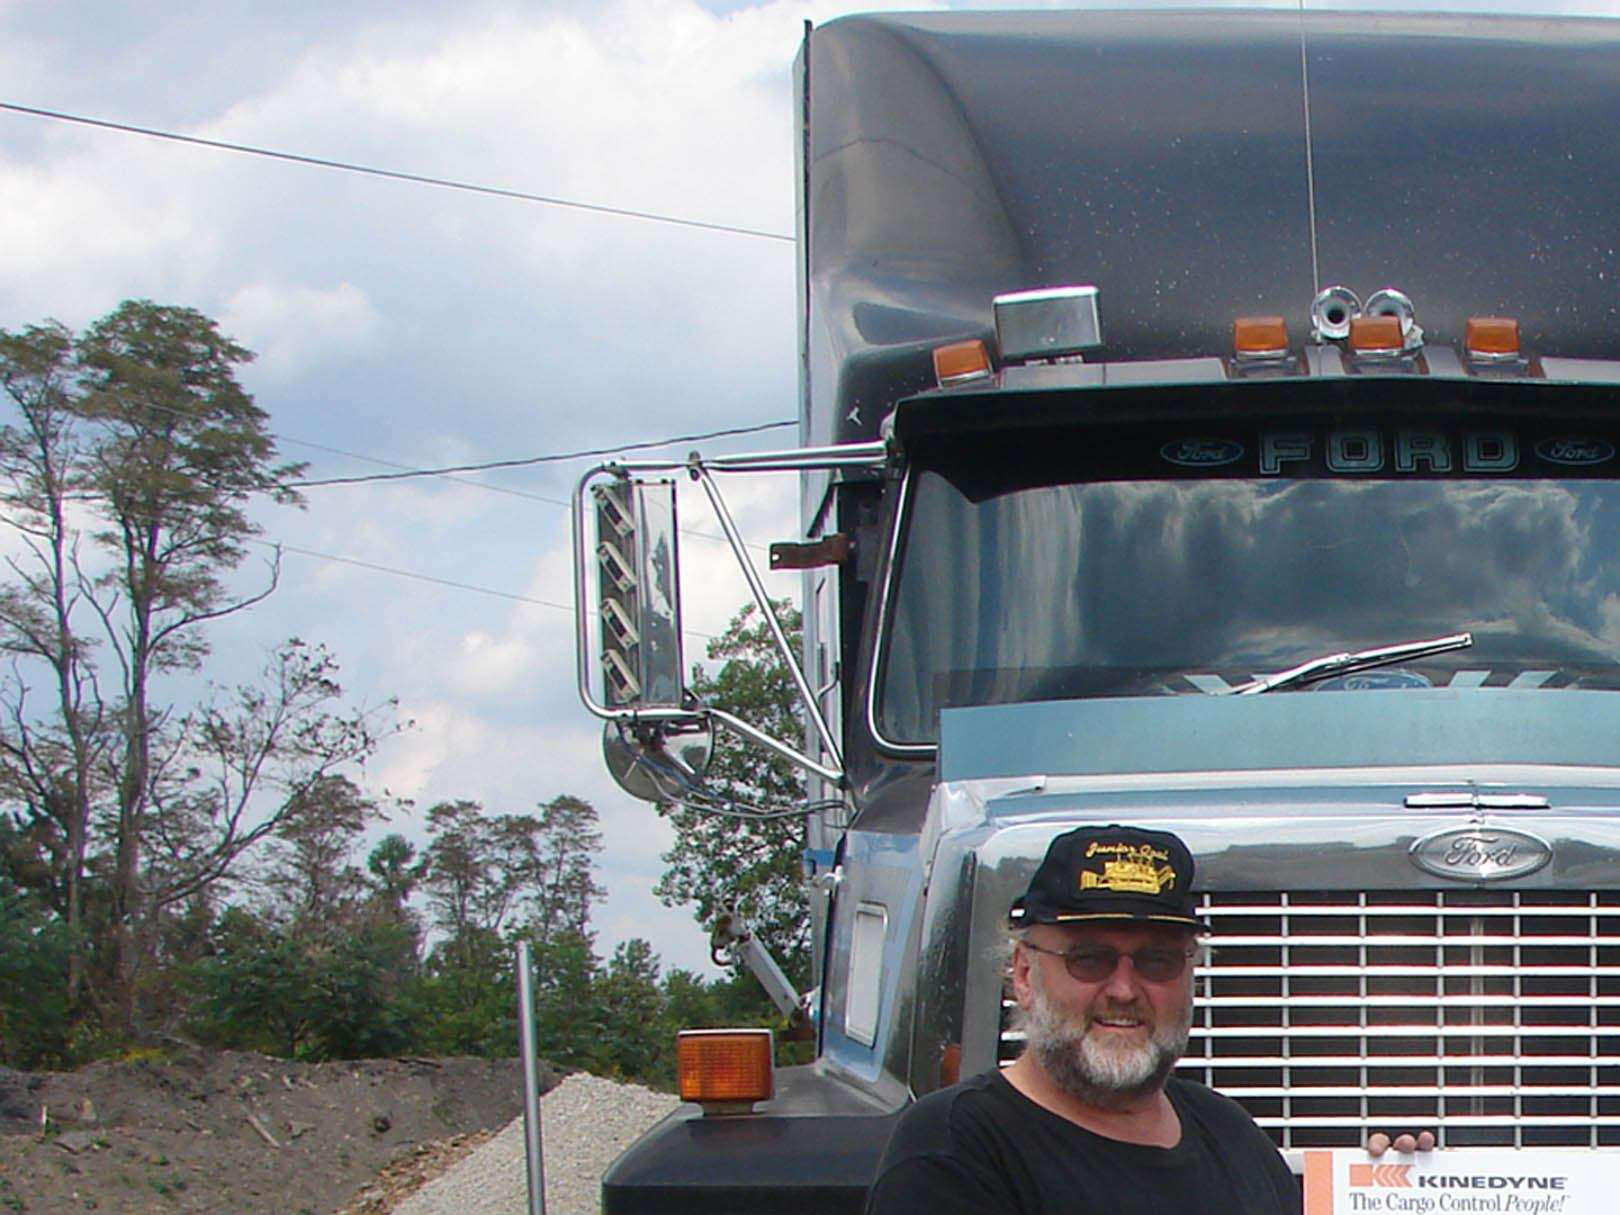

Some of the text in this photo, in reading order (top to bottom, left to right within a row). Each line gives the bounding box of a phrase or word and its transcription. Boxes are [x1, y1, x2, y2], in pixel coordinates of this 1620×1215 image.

[1177, 439, 1227, 462] Ford
[1258, 430, 1521, 475] FORD
[1549, 437, 1601, 461] Ford
[1444, 836, 1520, 867] Ford
[1418, 1175, 1566, 1190] KINEDYNE
[1349, 1192, 1567, 1215] The Cargo Control People!
